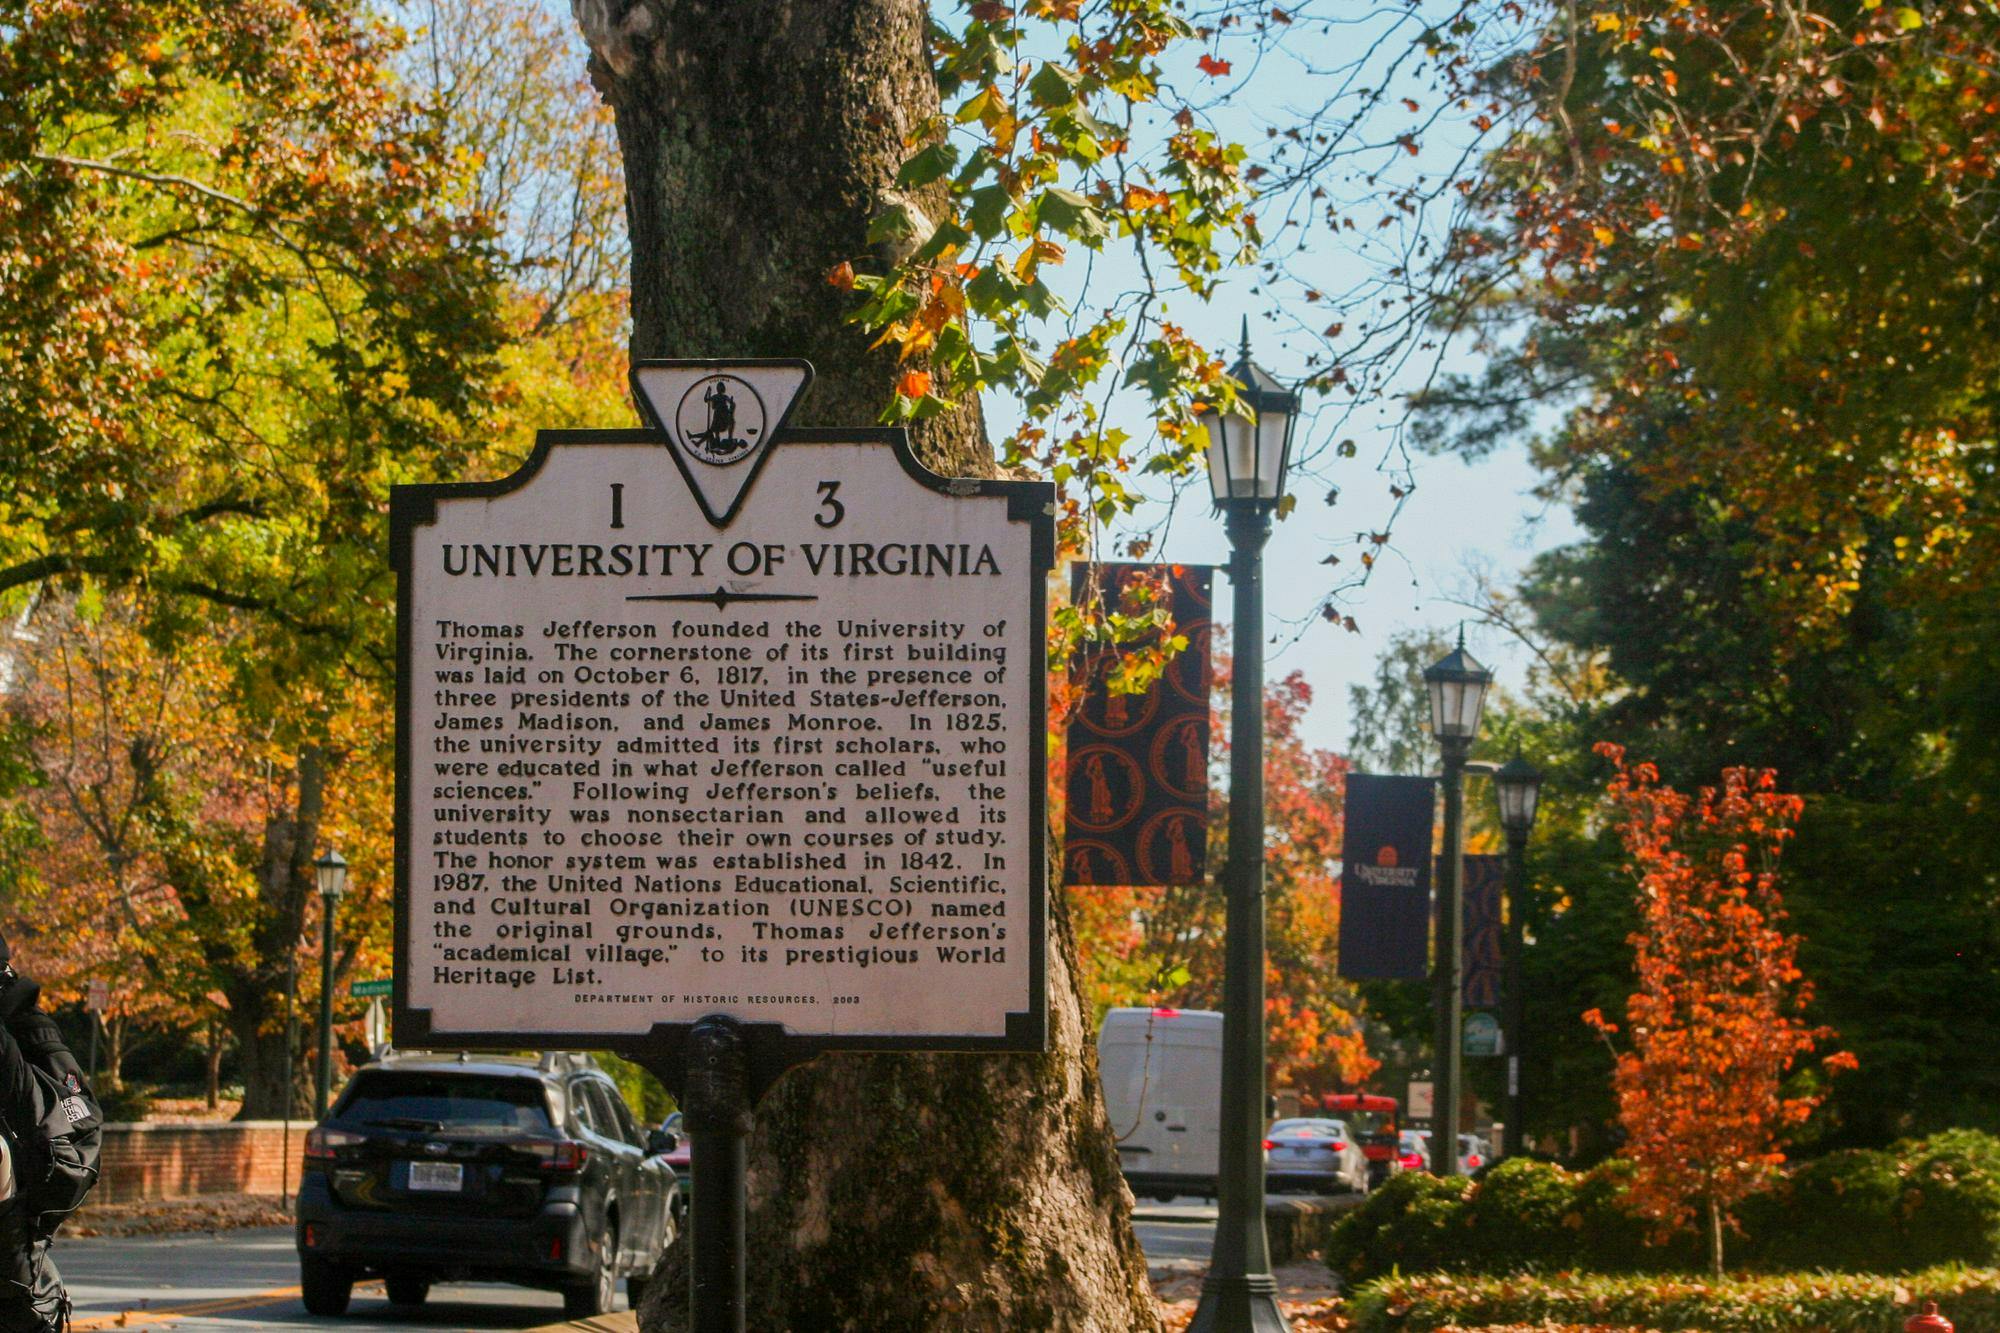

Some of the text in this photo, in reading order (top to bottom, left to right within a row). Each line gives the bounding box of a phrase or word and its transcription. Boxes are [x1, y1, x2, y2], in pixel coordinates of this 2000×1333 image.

[814, 481, 845, 528] 3
[442, 542, 1001, 577] UNIVERSITY OF VIRGINIA
[436, 620, 1006, 640] Thomas Jefferson founded the University of
[436, 642, 1006, 665] Virginia. The cornerstone of its first building
[435, 666, 1006, 687] was laid on October 6, 1817, in the presence of
[435, 690, 496, 707] three
[511, 689, 630, 709] presidents
[642, 690, 664, 707] of
[674, 691, 709, 707] the
[721, 689, 795, 708] United
[435, 712, 1006, 732] James Madison, and James Monroe. In 1825,
[434, 734, 1005, 756] the university admitted its first scholars, who
[434, 763, 488, 776] were
[497, 760, 600, 777] educated
[613, 758, 632, 777] in
[644, 760, 697, 776] what
[711, 759, 823, 777] Jefferson
[835, 760, 905, 776] called
[573, 782, 688, 804] Following
[706, 782, 837, 801] Jefferson's
[856, 782, 939, 801] beliefs,
[968, 783, 1005, 800] the
[434, 804, 1006, 826] university was nonsectarian and allowed its
[433, 828, 1005, 848] students to choose their own courses of study.
[434, 851, 1005, 872] The honor system was established in 1842. In
[434, 873, 1005, 894] 1987, the United Nations Educational, Scientific,
[434, 898, 1005, 920] and Cultural Organization (UNESCO) named
[434, 920, 1005, 943] the original grounds, Thomas Jefferson's
[701, 947, 724, 962] to
[742, 945, 767, 962] its
[786, 945, 918, 967] prestigious
[936, 947, 1005, 963] World
[434, 967, 602, 988] Heritage List.
[575, 994, 653, 1003] DEPARTMENT
[662, 995, 675, 1003] OF
[684, 995, 738, 1003] HISTORIC
[833, 996, 859, 1004] 2003
